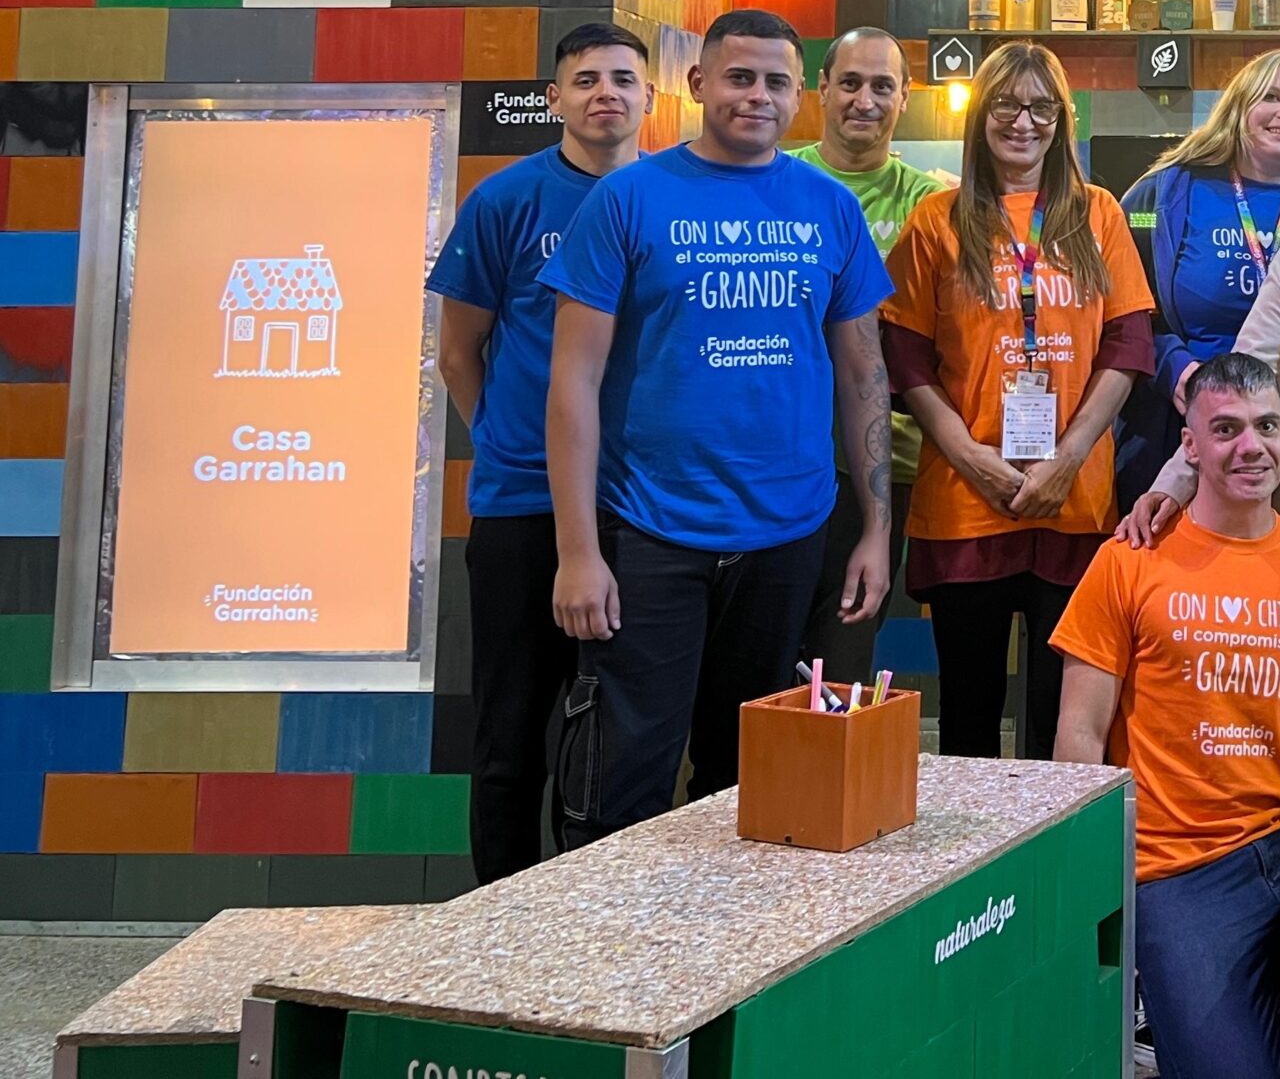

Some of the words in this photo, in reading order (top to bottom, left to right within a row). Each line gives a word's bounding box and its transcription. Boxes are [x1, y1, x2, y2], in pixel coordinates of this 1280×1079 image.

[494, 92, 550, 108] Funda
[670, 220, 707, 245] CON
[1212, 228, 1244, 247] CON
[675, 250, 691, 264] el
[696, 249, 798, 266] compromiso
[802, 253, 818, 265] es
[1216, 249, 1230, 259] el
[701, 270, 799, 310] GRANDE
[707, 334, 790, 352] Fundación
[708, 351, 787, 368] Garrahan
[231, 425, 311, 452] Casa
[193, 455, 346, 483] Garrahan
[213, 583, 313, 602] Fundación
[214, 602, 309, 622] Garrahan
[1168, 592, 1207, 621] CON
[1172, 626, 1188, 641] el
[1200, 721, 1274, 741] Fundación
[1200, 740, 1269, 757] Garrahan
[934, 894, 1016, 965] naturaleza
